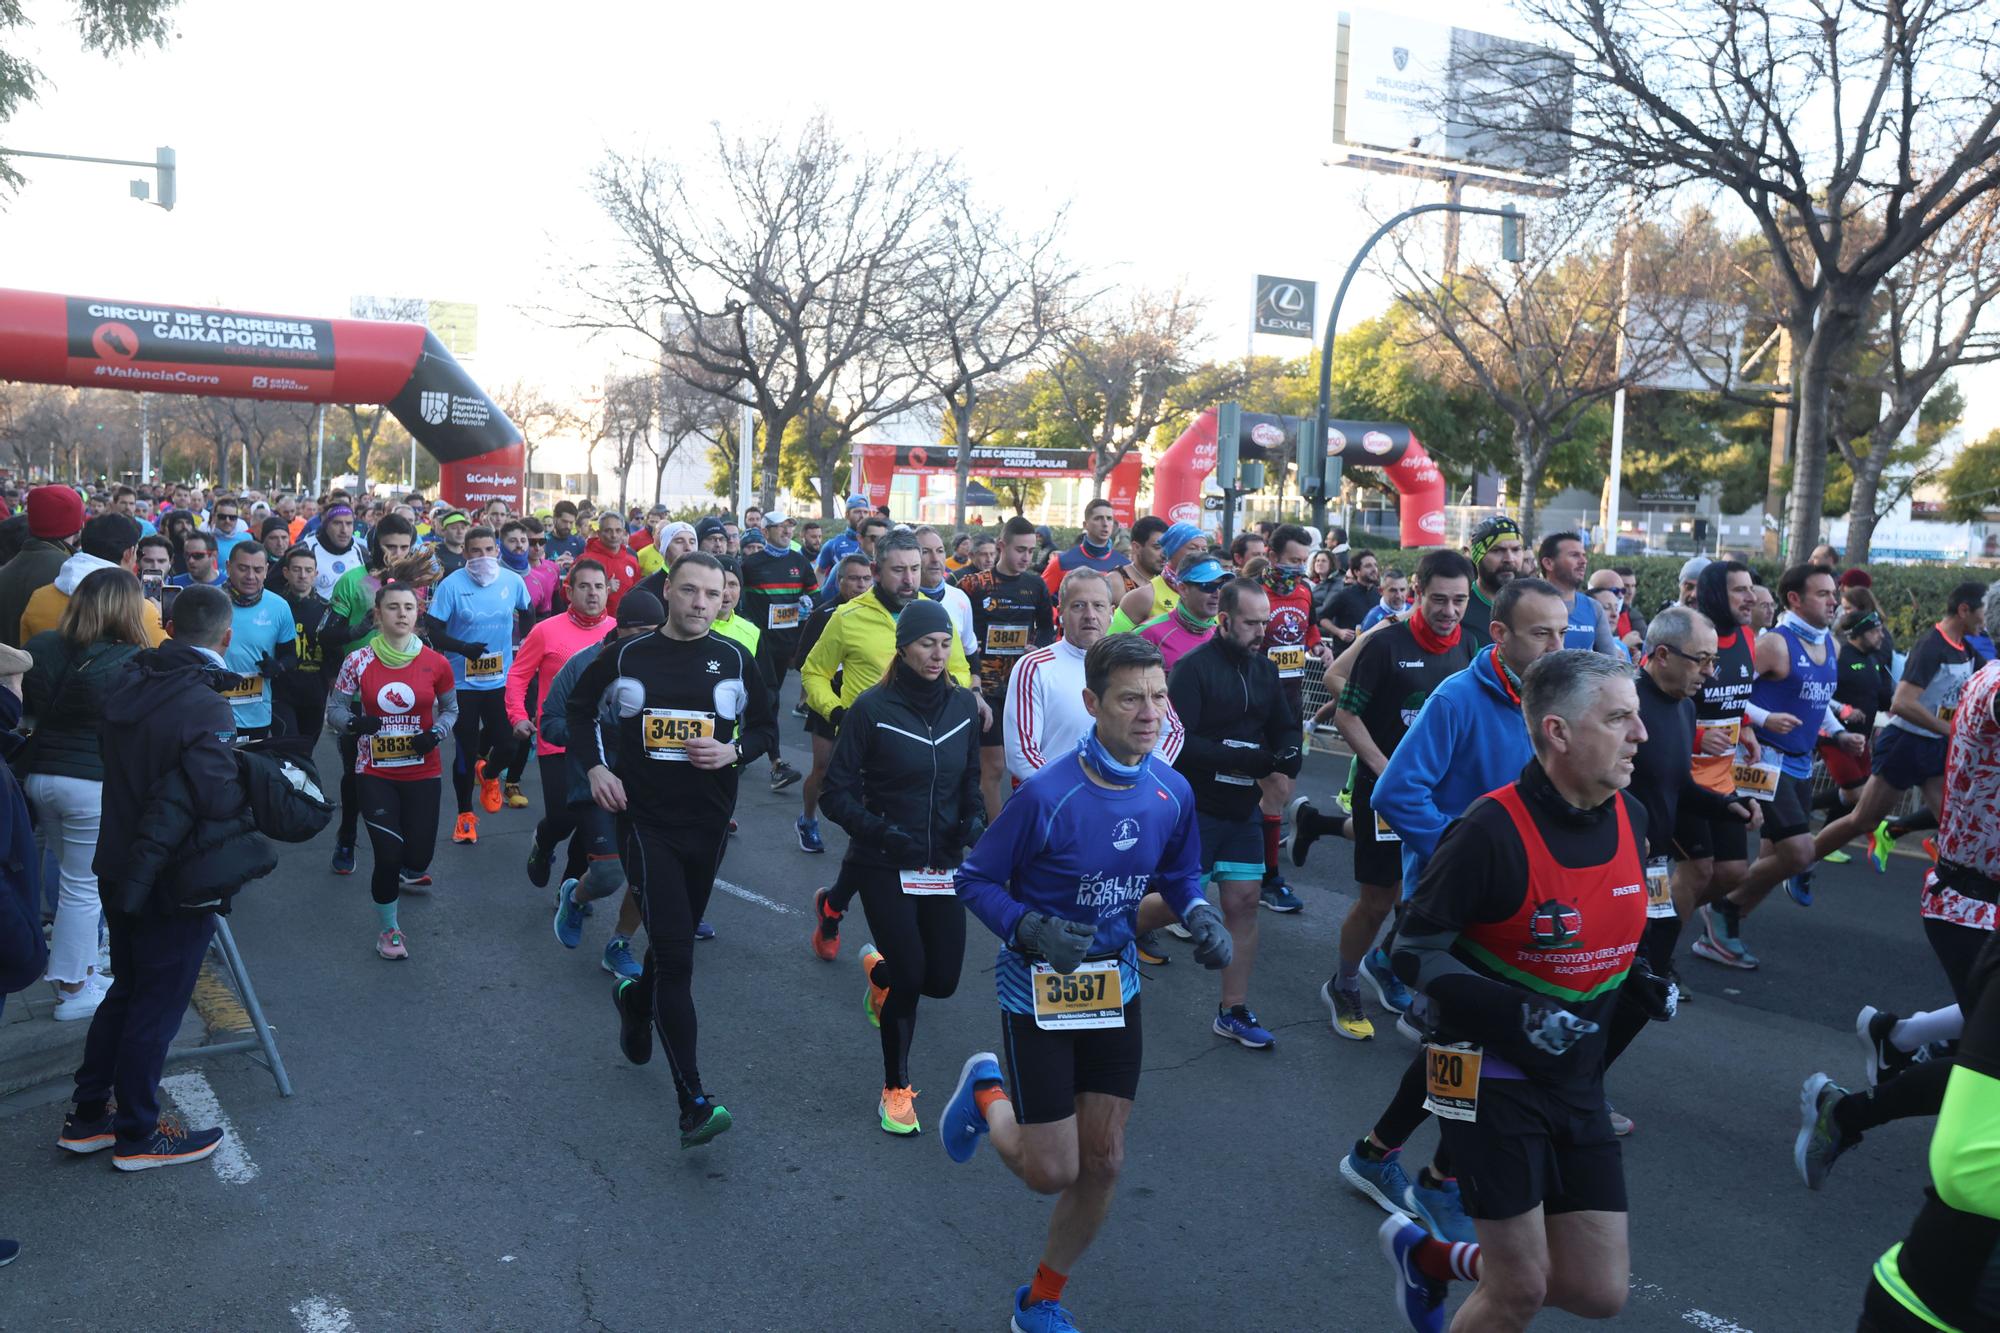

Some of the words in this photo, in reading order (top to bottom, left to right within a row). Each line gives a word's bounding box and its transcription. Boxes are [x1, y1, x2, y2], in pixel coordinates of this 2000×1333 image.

[88, 304, 170, 324] CIRCUIT
[175, 312, 203, 326] DE
[206, 315, 313, 336] CARRERES
[1260, 317, 1311, 331] LEXUS
[94, 365, 219, 385] #ValènciaCorre
[981, 450, 992, 458] DE
[993, 450, 1036, 459] CARRERES
[994, 631, 1020, 643] 3847
[471, 658, 497, 670] 3788
[1275, 652, 1299, 665] 3812
[1704, 684, 1752, 699] VALENCIA
[1720, 699, 1747, 711] FASTE
[379, 715, 410, 724] RCUIT
[411, 715, 421, 724] DE
[380, 724, 420, 732] ARRERES
[652, 719, 702, 741] 3453
[1734, 767, 1768, 785] 3507
[1612, 884, 1640, 897] FASTER
[1517, 951, 1544, 963] THE
[1544, 951, 1595, 963] KENYAN
[1046, 974, 1105, 1003] 3537
